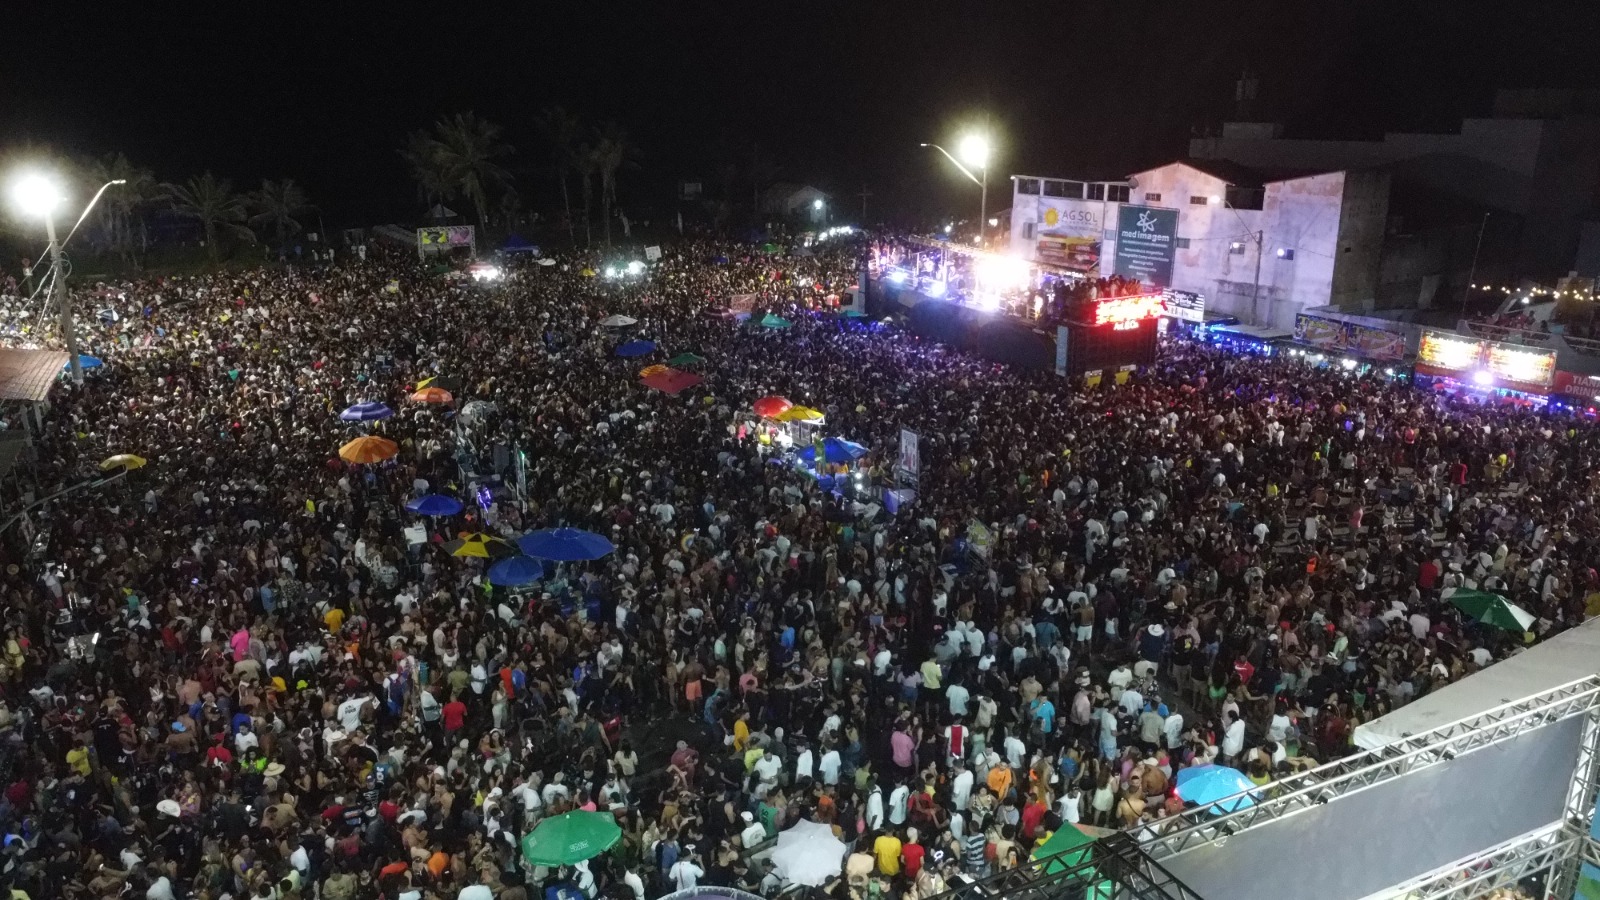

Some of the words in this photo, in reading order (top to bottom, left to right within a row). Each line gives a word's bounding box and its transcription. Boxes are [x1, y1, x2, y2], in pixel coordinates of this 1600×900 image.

[1062, 210, 1076, 221] AG
[1078, 211, 1098, 223] SOL
[1564, 384, 1600, 397] DRINK
